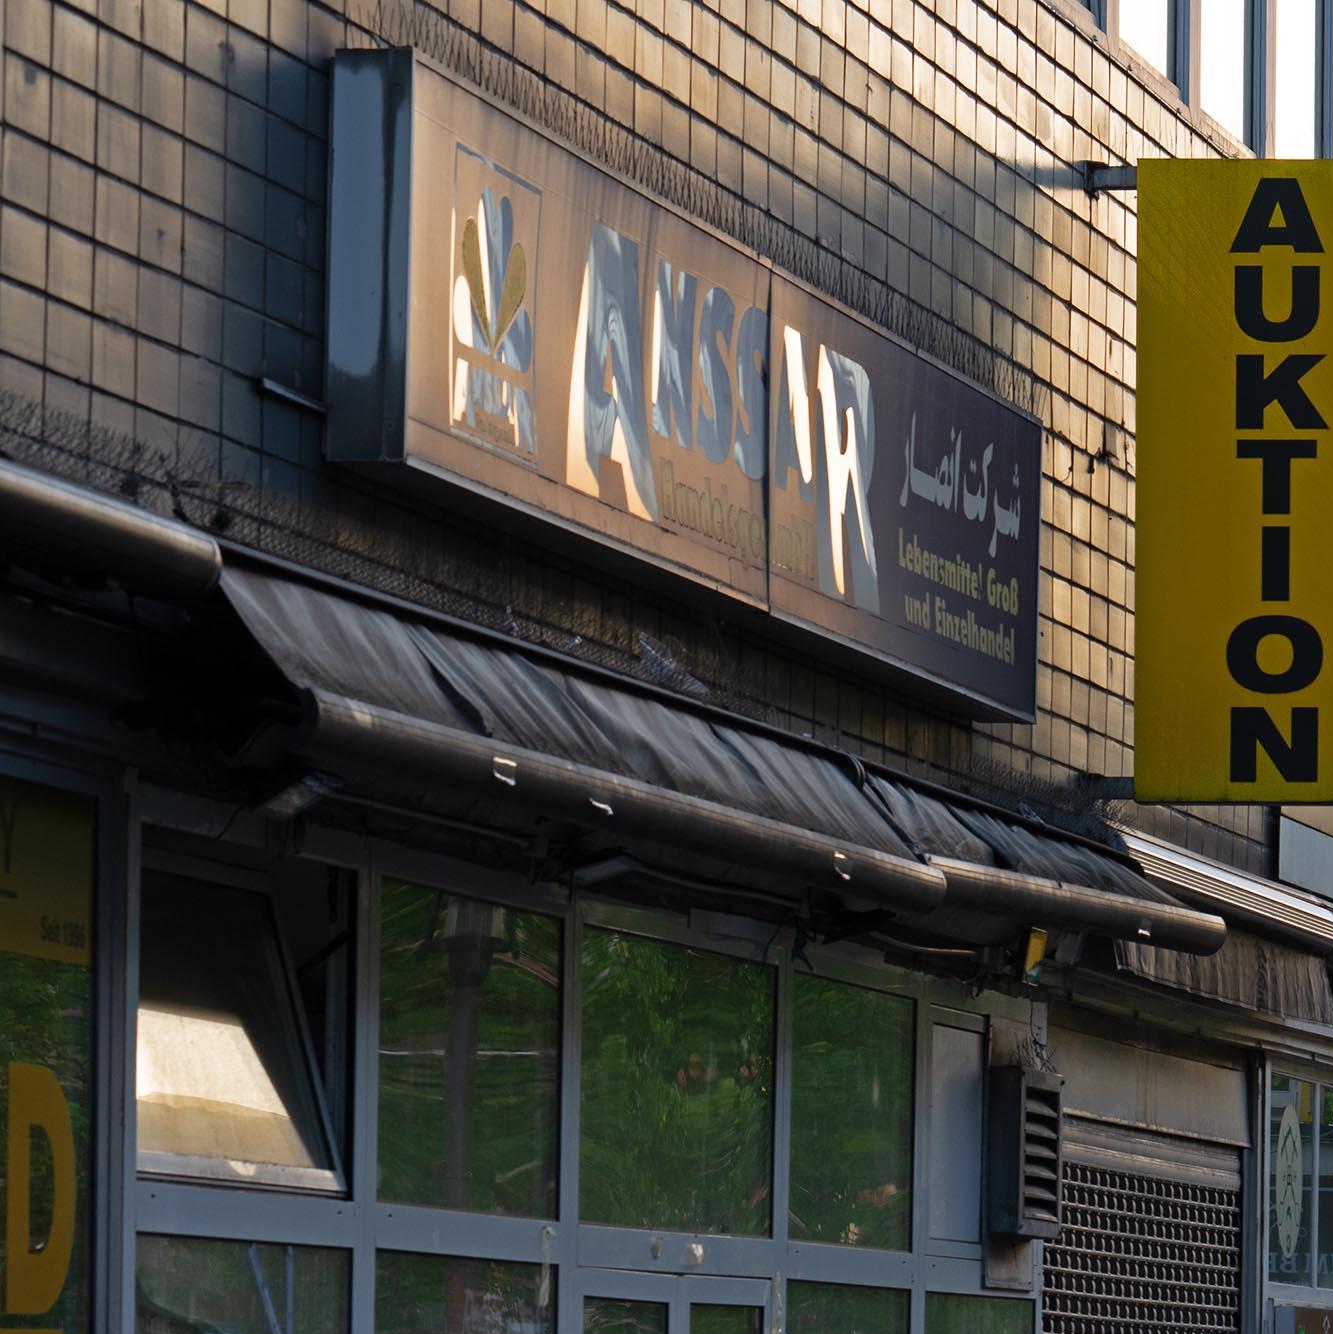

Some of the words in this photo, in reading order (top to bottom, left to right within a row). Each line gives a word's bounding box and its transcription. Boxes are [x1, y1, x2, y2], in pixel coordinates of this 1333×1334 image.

[565, 217, 881, 612] ANSAR
[1226, 177, 1331, 783] AUKTION
[899, 528, 982, 599] Lebensmittel
[986, 570, 1019, 616] Groß
[904, 592, 931, 630] und
[935, 596, 1015, 665] Einzelhandel
